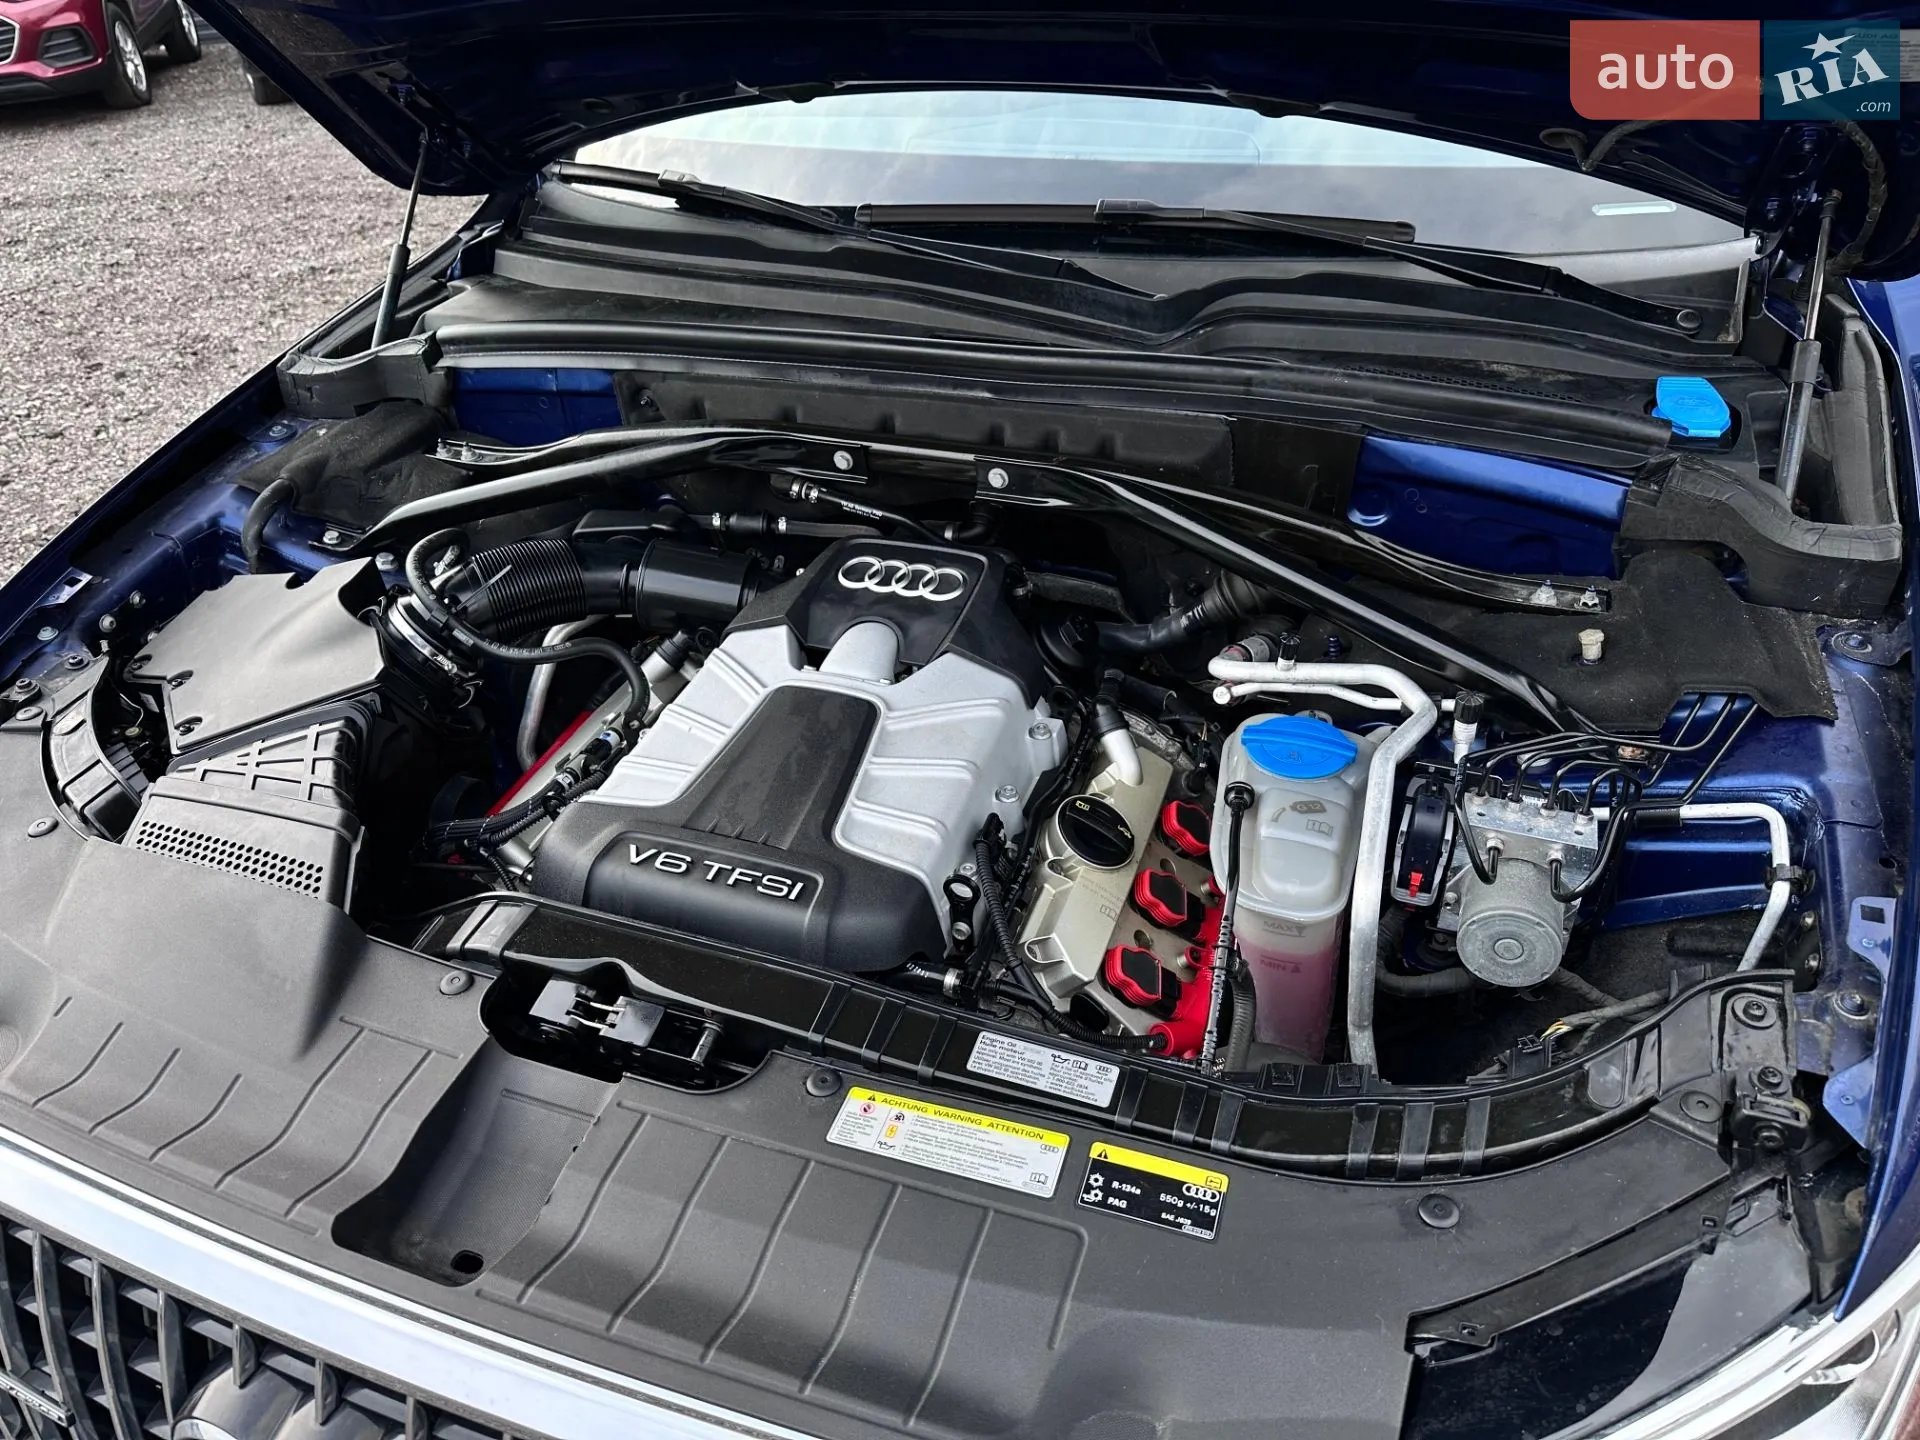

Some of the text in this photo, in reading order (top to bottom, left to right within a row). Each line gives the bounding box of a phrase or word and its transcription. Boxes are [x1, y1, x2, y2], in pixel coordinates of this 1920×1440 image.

[629, 844, 804, 901] V6 TFSI
[1263, 921, 1294, 932] MAX
[1260, 959, 1286, 972] MIN
[981, 1034, 1006, 1045] Engine
[980, 1040, 997, 1049] Huile
[999, 1046, 1025, 1055] moteur
[881, 1097, 928, 1114] ACHTUNG
[933, 1109, 982, 1126] WARNING
[988, 1122, 1044, 1140] ATTENTION
[1111, 1180, 1141, 1195] R-134a
[1107, 1196, 1128, 1209] PAG
[1159, 1193, 1184, 1208] 550g
